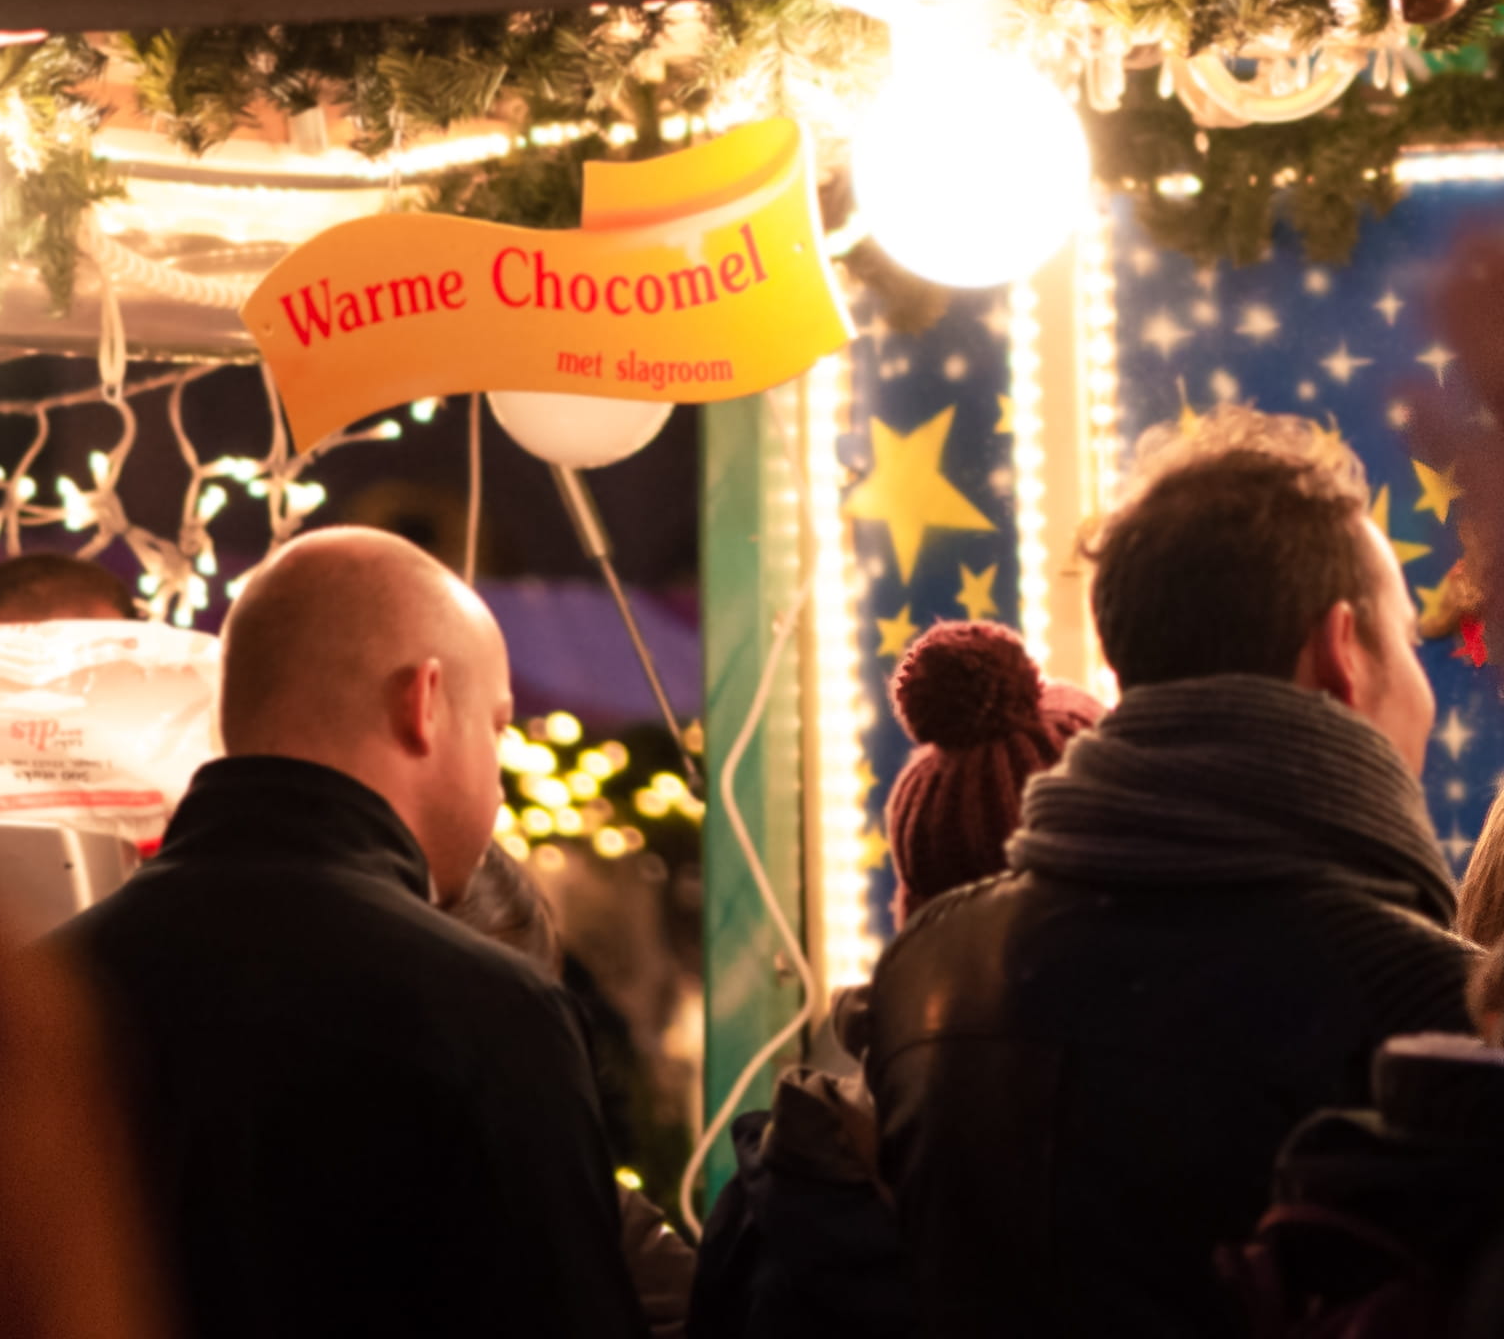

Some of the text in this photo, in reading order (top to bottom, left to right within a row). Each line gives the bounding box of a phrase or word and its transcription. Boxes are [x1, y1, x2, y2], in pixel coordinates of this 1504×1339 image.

[279, 224, 768, 348] Warme Chocomel
[556, 349, 733, 391] met slagroom
